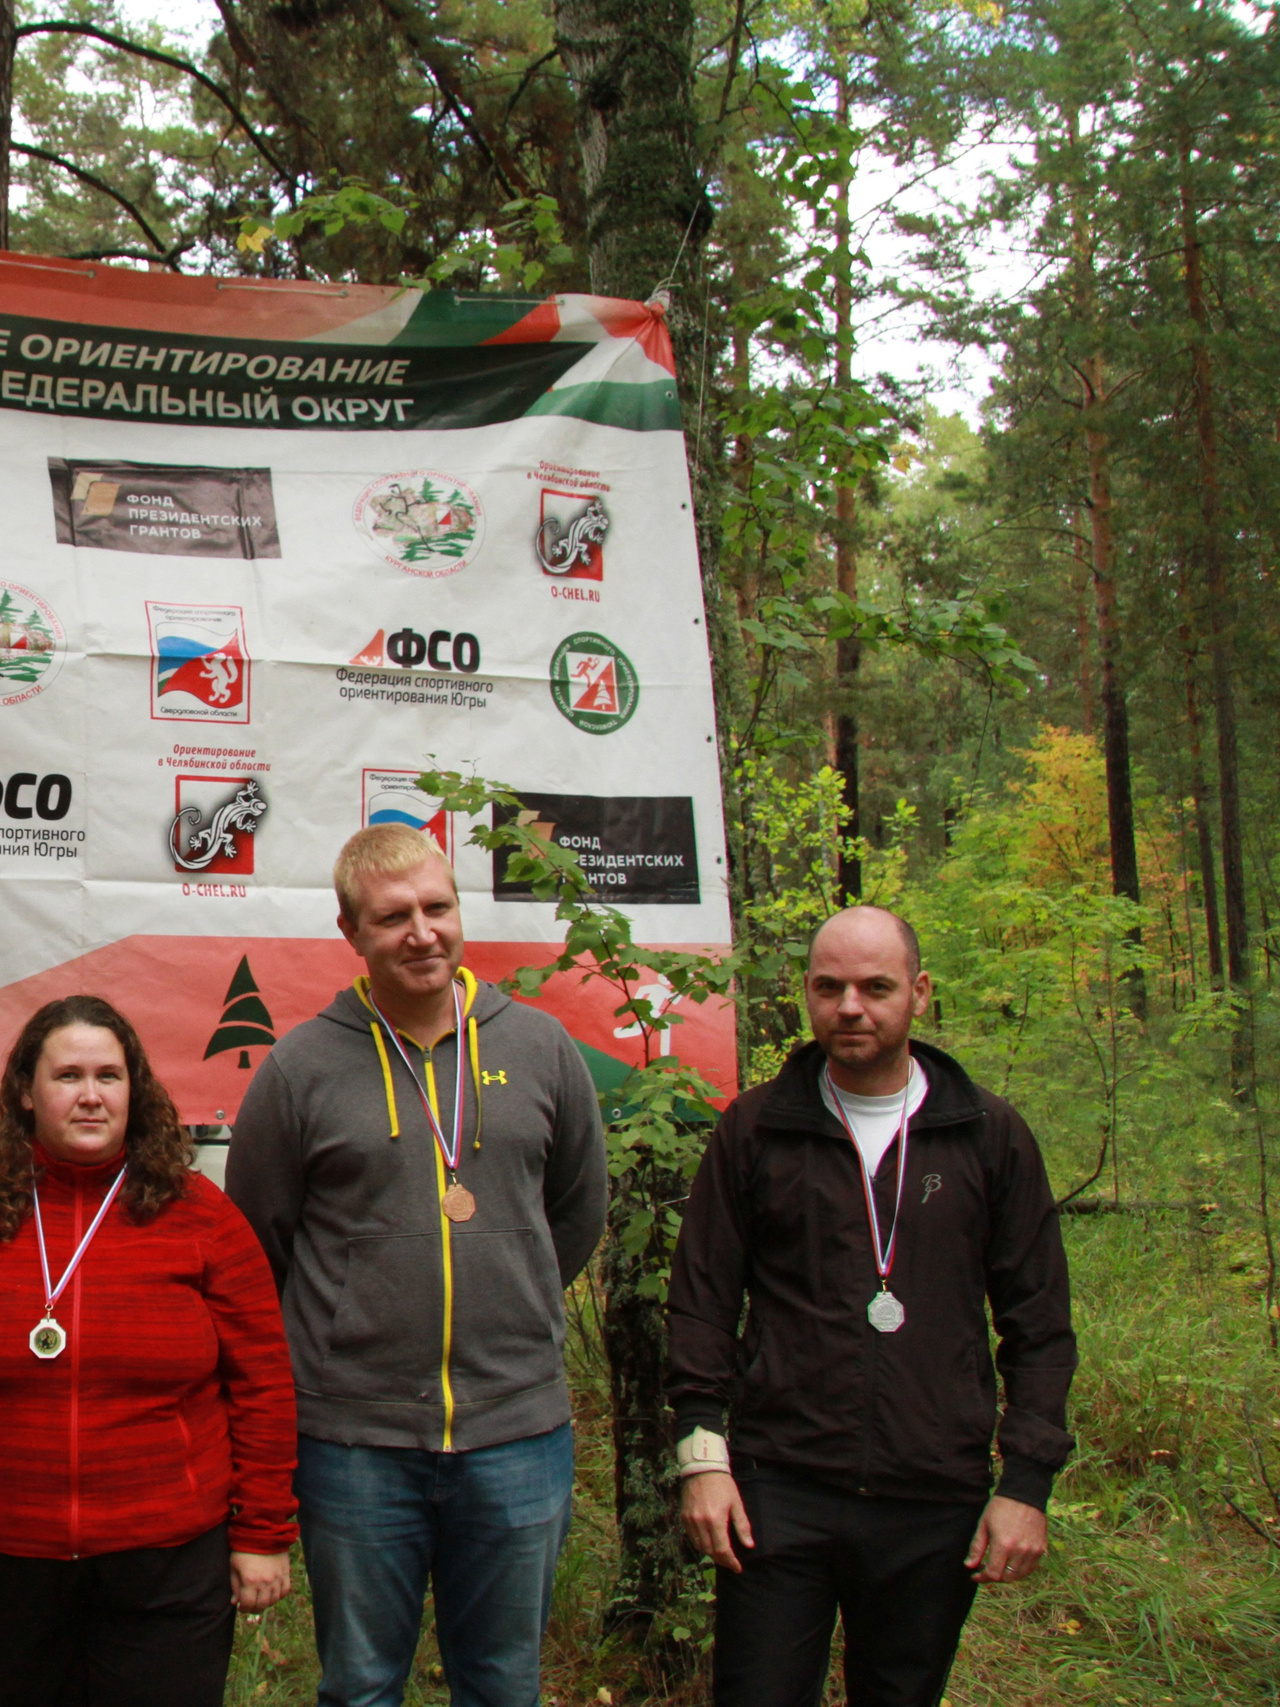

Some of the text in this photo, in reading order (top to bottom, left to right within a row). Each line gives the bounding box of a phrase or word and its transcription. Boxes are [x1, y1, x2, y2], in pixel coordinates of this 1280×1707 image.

[20, 333, 412, 386] ОРИЕНТИРОВАНИЕ
[291, 395, 415, 423] ОКРУГ
[126, 493, 174, 508] ФОНД
[128, 508, 262, 527] ПРЕЗИДЕНТСКИХ
[129, 524, 202, 539] ГРАНТОВ
[550, 585, 600, 602] O-CHEL.RU
[8, 582, 63, 640] ОРИЕНТИРОВАНИЯ
[386, 627, 481, 674] ФСО
[336, 667, 494, 693] Федерация спортивного
[2, 684, 43, 706] ОБЛАСТИ
[340, 686, 486, 710] ориентирования Югры
[173, 743, 256, 758] Ориентирование
[158, 757, 271, 771] в Челябинской области
[33, 842, 77, 861] Югры
[559, 836, 601, 850] ФОНД
[573, 854, 685, 868] ЕЗИДЕНТСКИХ
[562, 873, 627, 885] НТОВ
[182, 883, 246, 898] O-CHEL.RU
